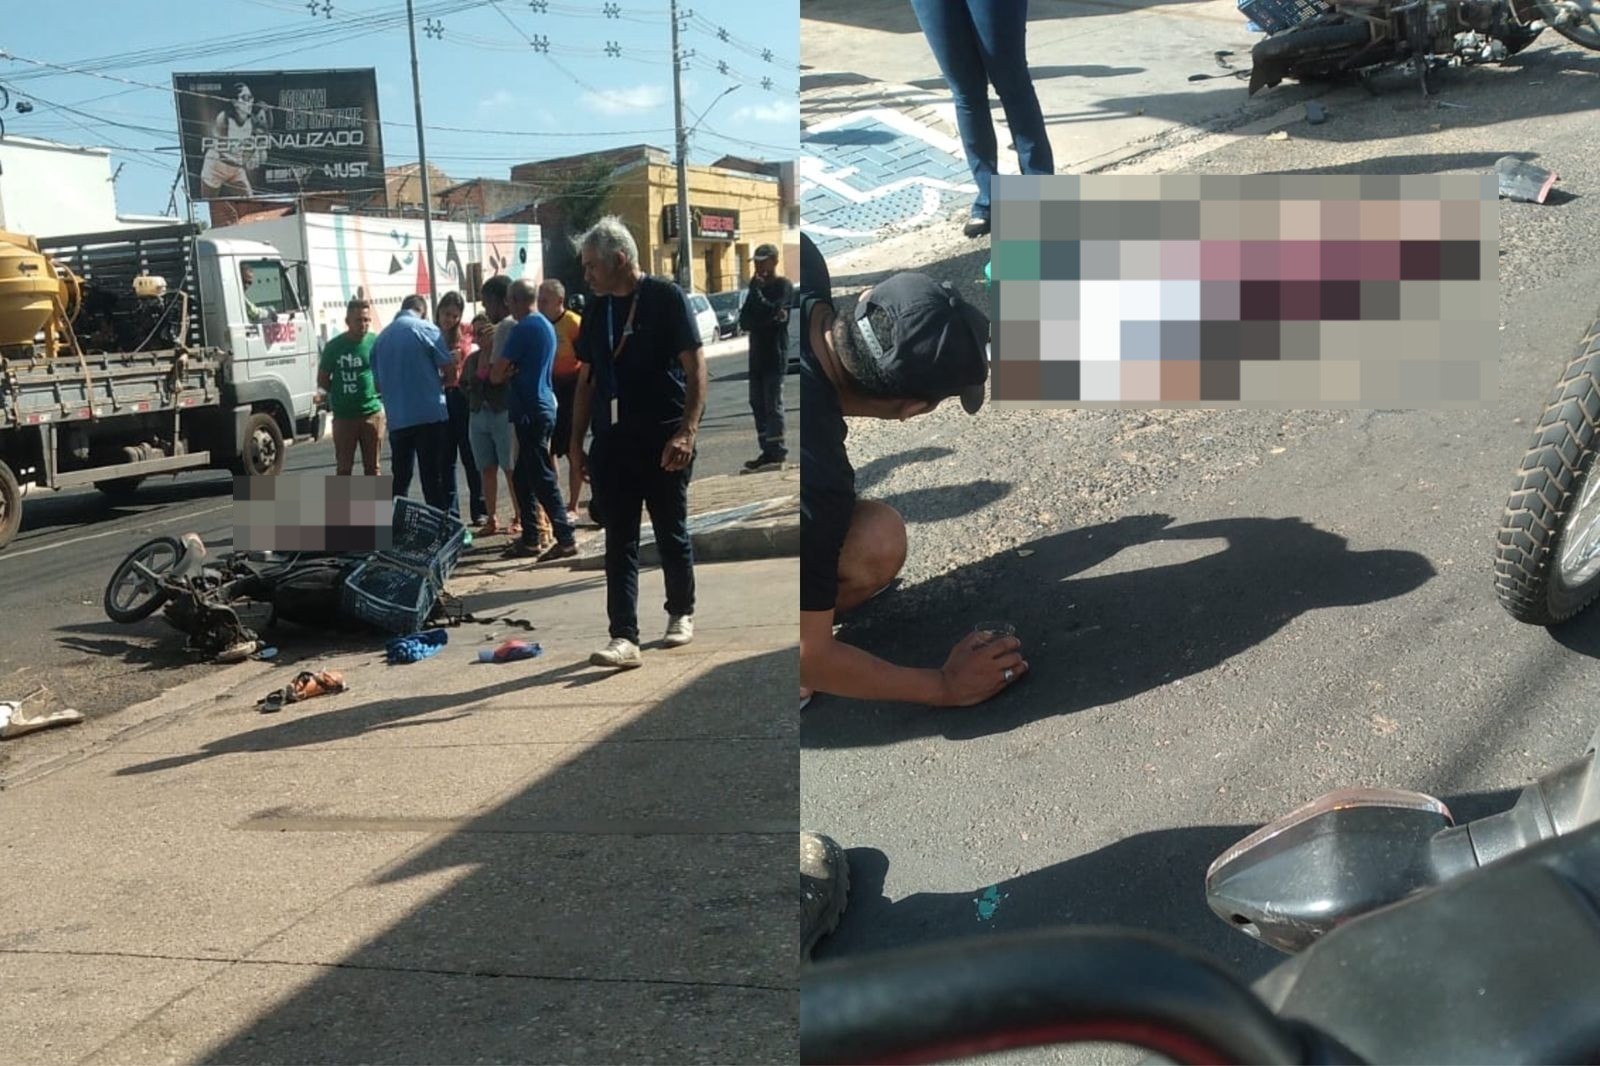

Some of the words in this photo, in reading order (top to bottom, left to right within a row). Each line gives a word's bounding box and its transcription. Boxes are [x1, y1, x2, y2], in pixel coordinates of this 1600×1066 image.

[201, 130, 364, 152] PERSONALIZADO
[342, 371, 357, 381] tu
[343, 383, 358, 394] re
